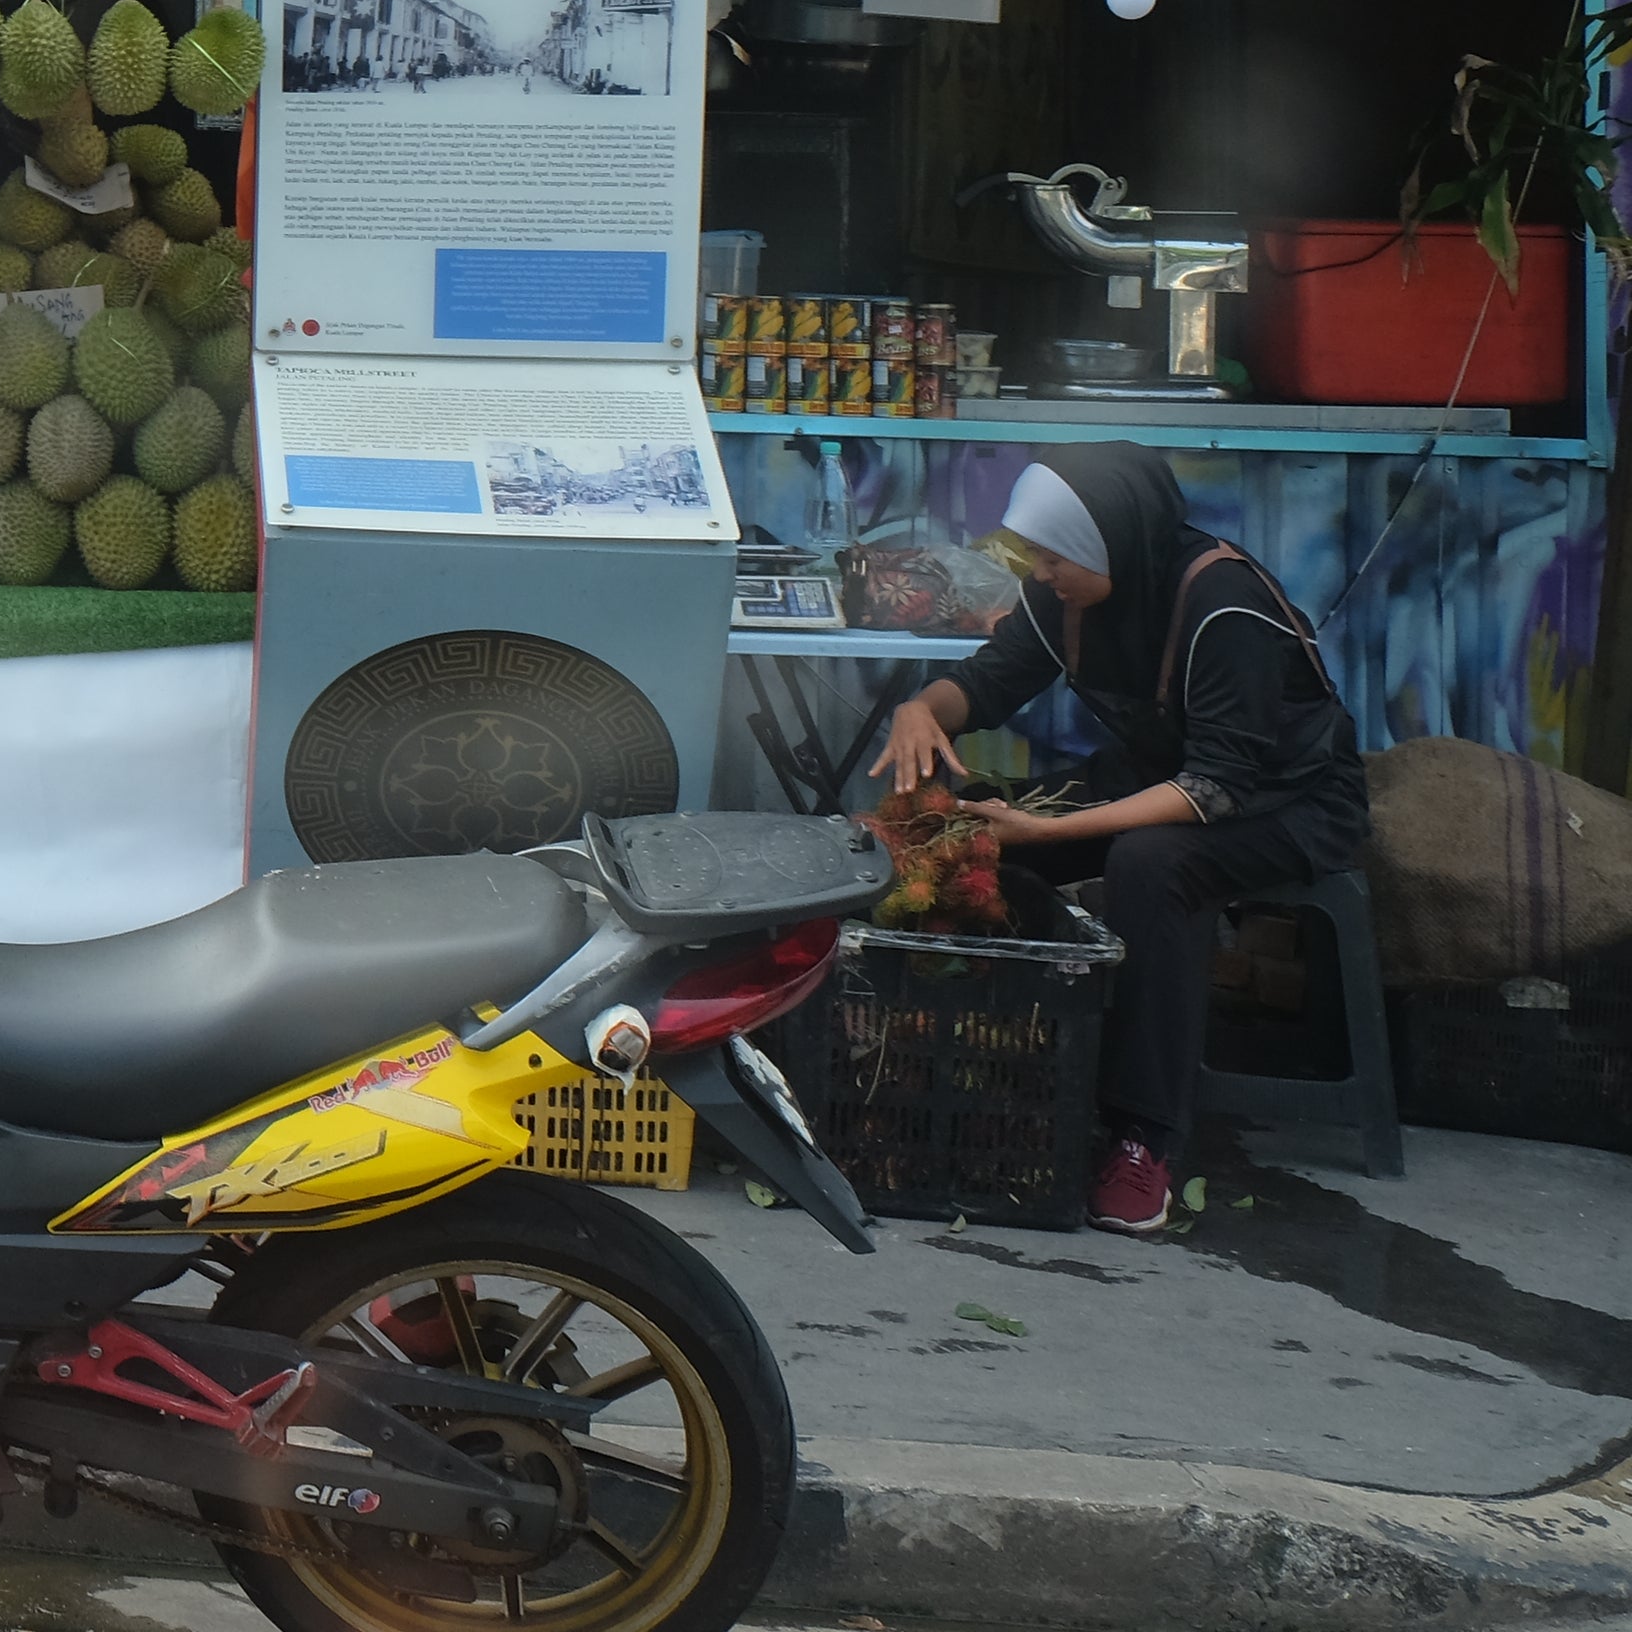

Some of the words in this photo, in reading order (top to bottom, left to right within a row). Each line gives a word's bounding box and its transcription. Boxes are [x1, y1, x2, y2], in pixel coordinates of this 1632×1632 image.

[308, 1085, 347, 1113] Red
[412, 1039, 453, 1071] Bull
[294, 1483, 349, 1507] elf
